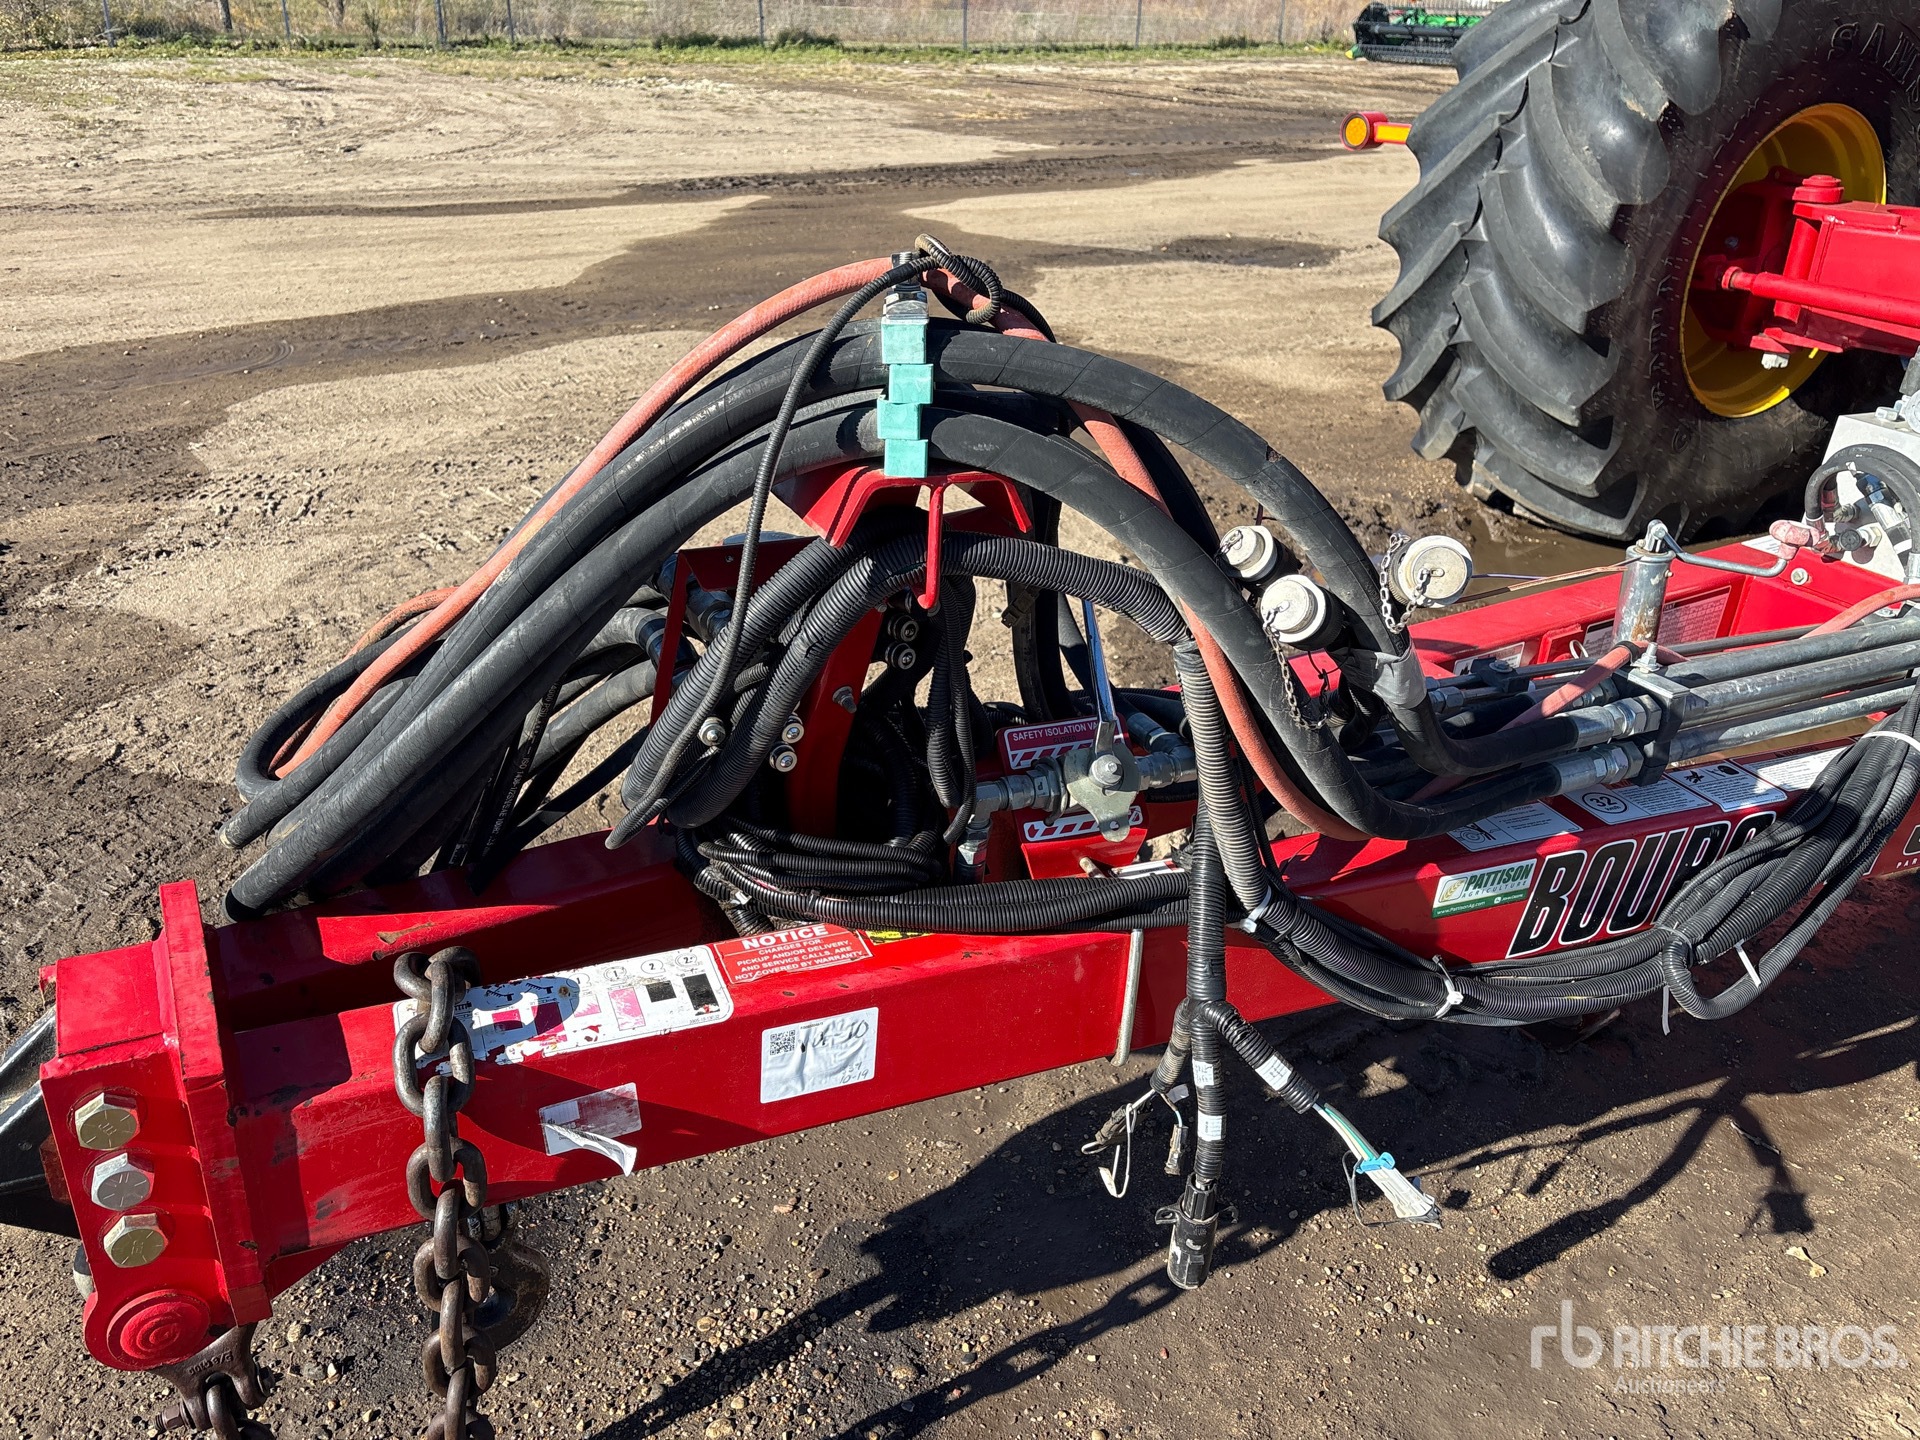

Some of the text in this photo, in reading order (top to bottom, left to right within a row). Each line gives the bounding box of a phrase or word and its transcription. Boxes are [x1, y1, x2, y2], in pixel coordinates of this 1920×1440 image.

[1013, 728, 1043, 742] SAFETY
[1044, 722, 1085, 737] ISOLATION
[1589, 796, 1617, 808] 32
[1465, 863, 1534, 892] PATTISON
[1461, 880, 1528, 899] AGRICULTURE
[1436, 901, 1487, 916] www.PattisonAg.com
[742, 925, 829, 951] NOTICE
[758, 938, 825, 956] CHARGES FOR:
[734, 950, 863, 981] NOT COVERED BY WARRANTY
[736, 956, 769, 967] PICKUP
[772, 950, 807, 961] AND/OR
[741, 963, 761, 973] AND
[762, 956, 801, 970] SERVICE
[833, 946, 853, 955] ARE
